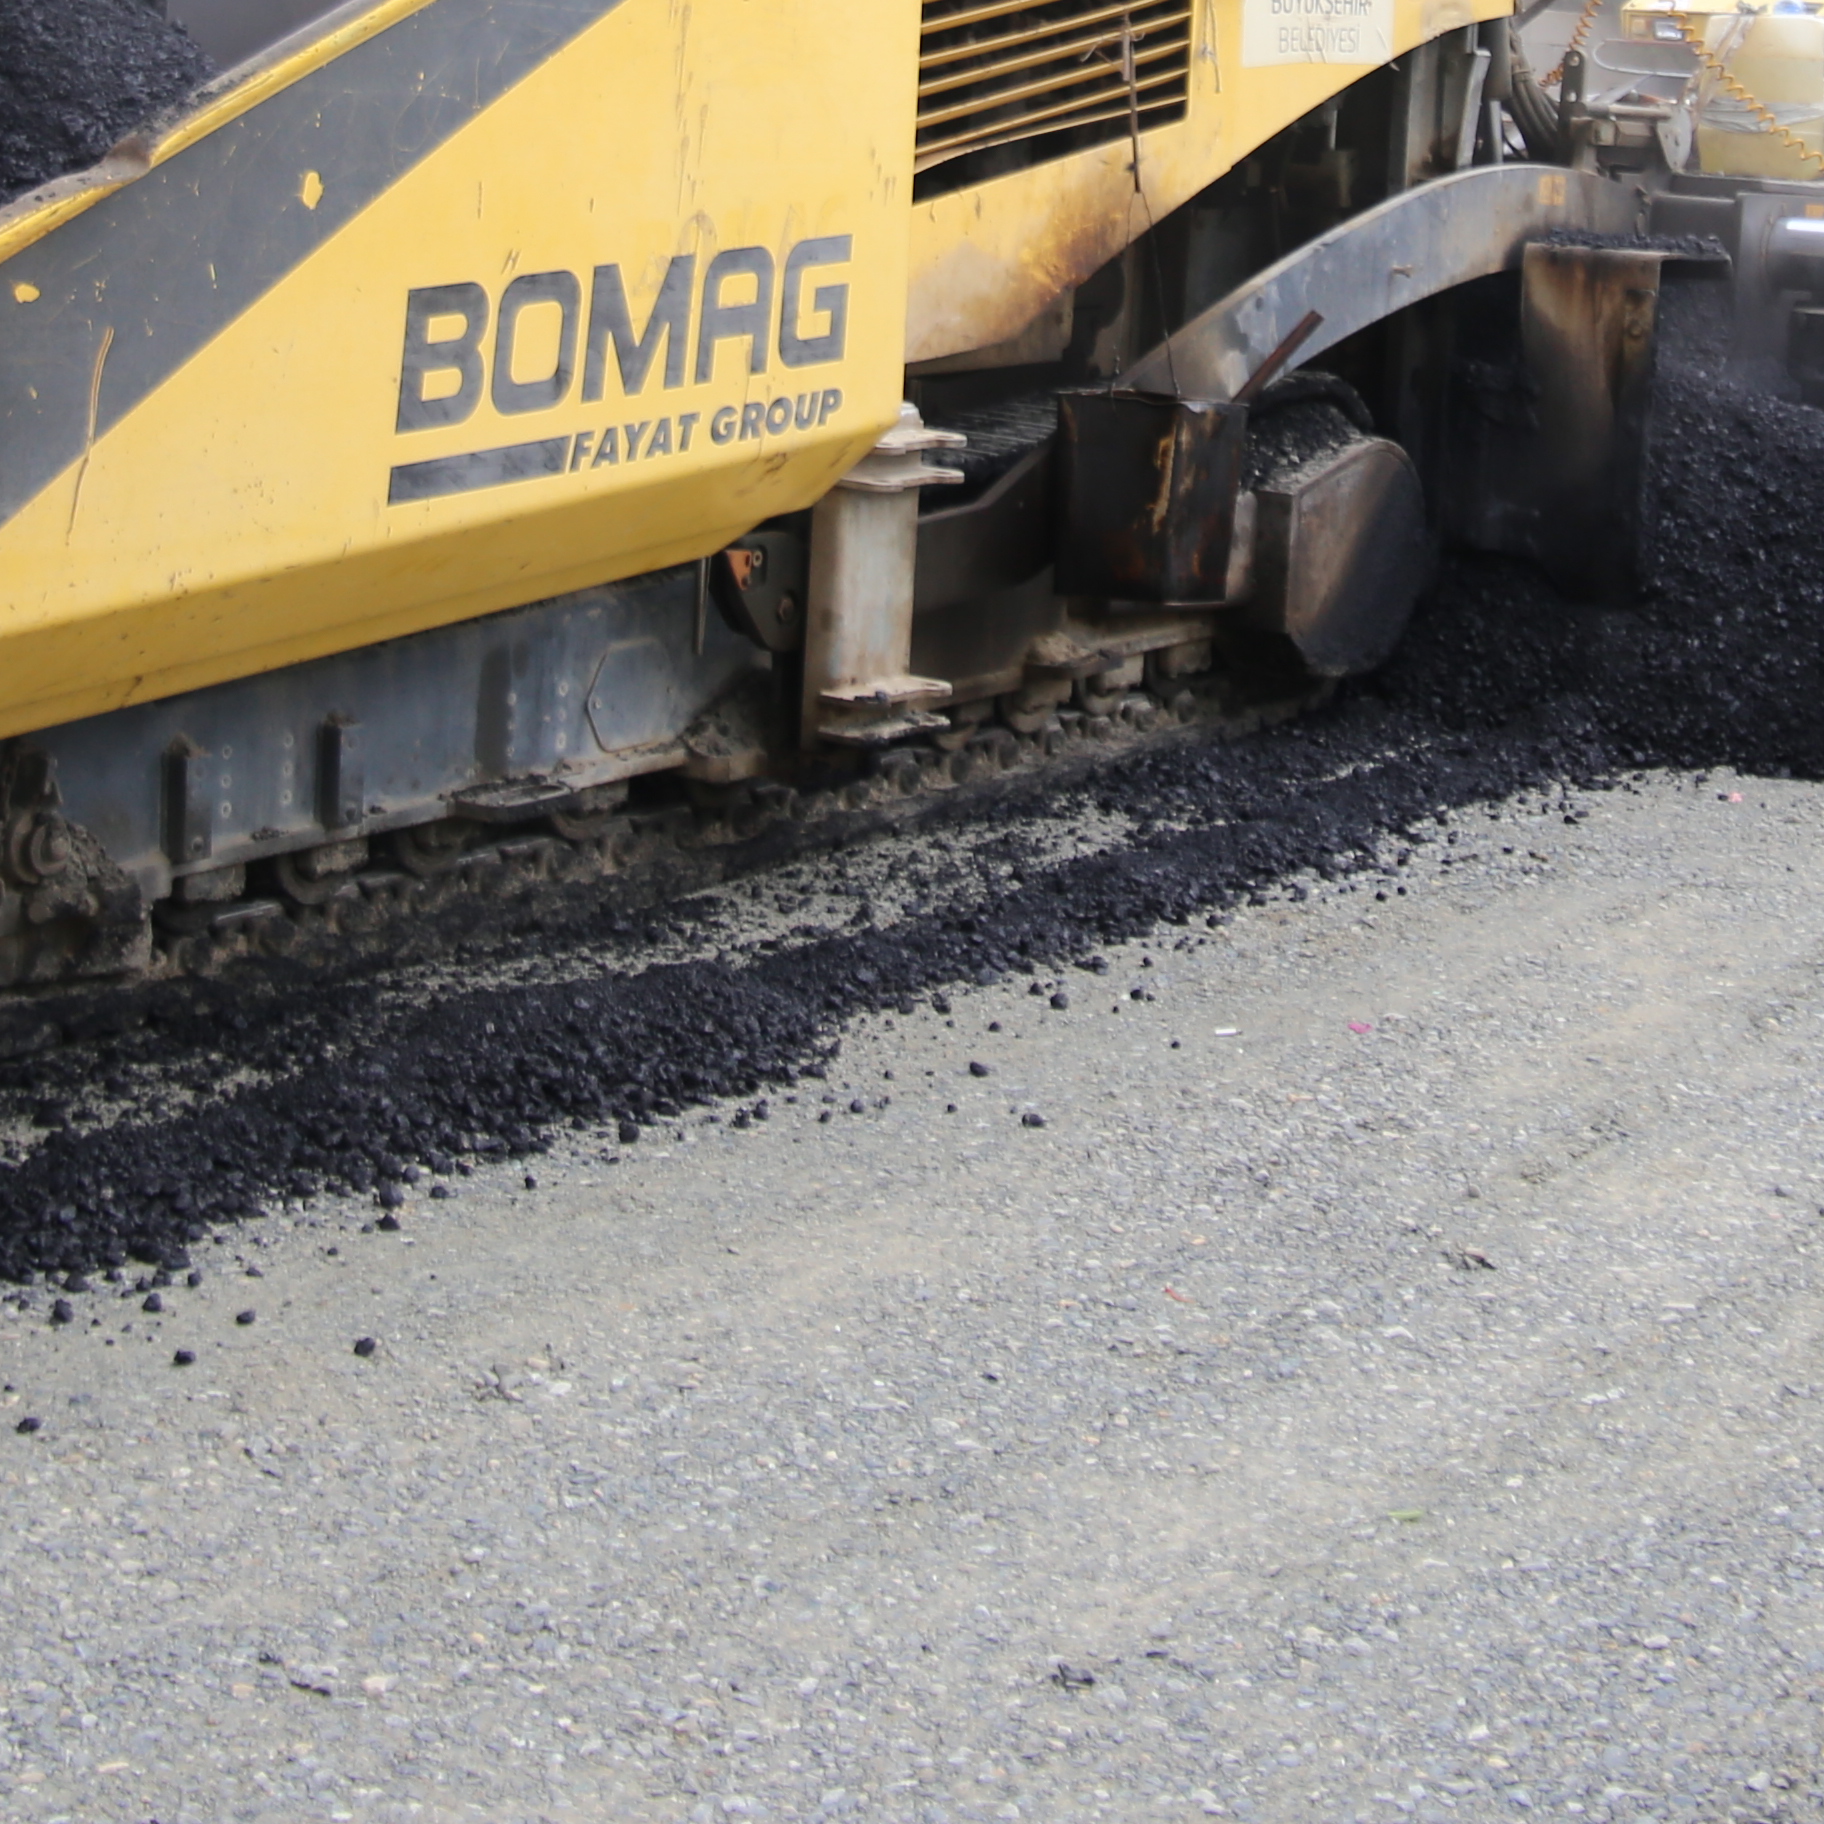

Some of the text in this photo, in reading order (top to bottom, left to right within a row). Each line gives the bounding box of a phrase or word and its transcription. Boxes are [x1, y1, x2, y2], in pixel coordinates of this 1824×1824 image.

[1278, 24, 1360, 54] BELEDİYESİ
[396, 234, 853, 435] BOMAG
[569, 388, 844, 473] FAYAT GROUP
